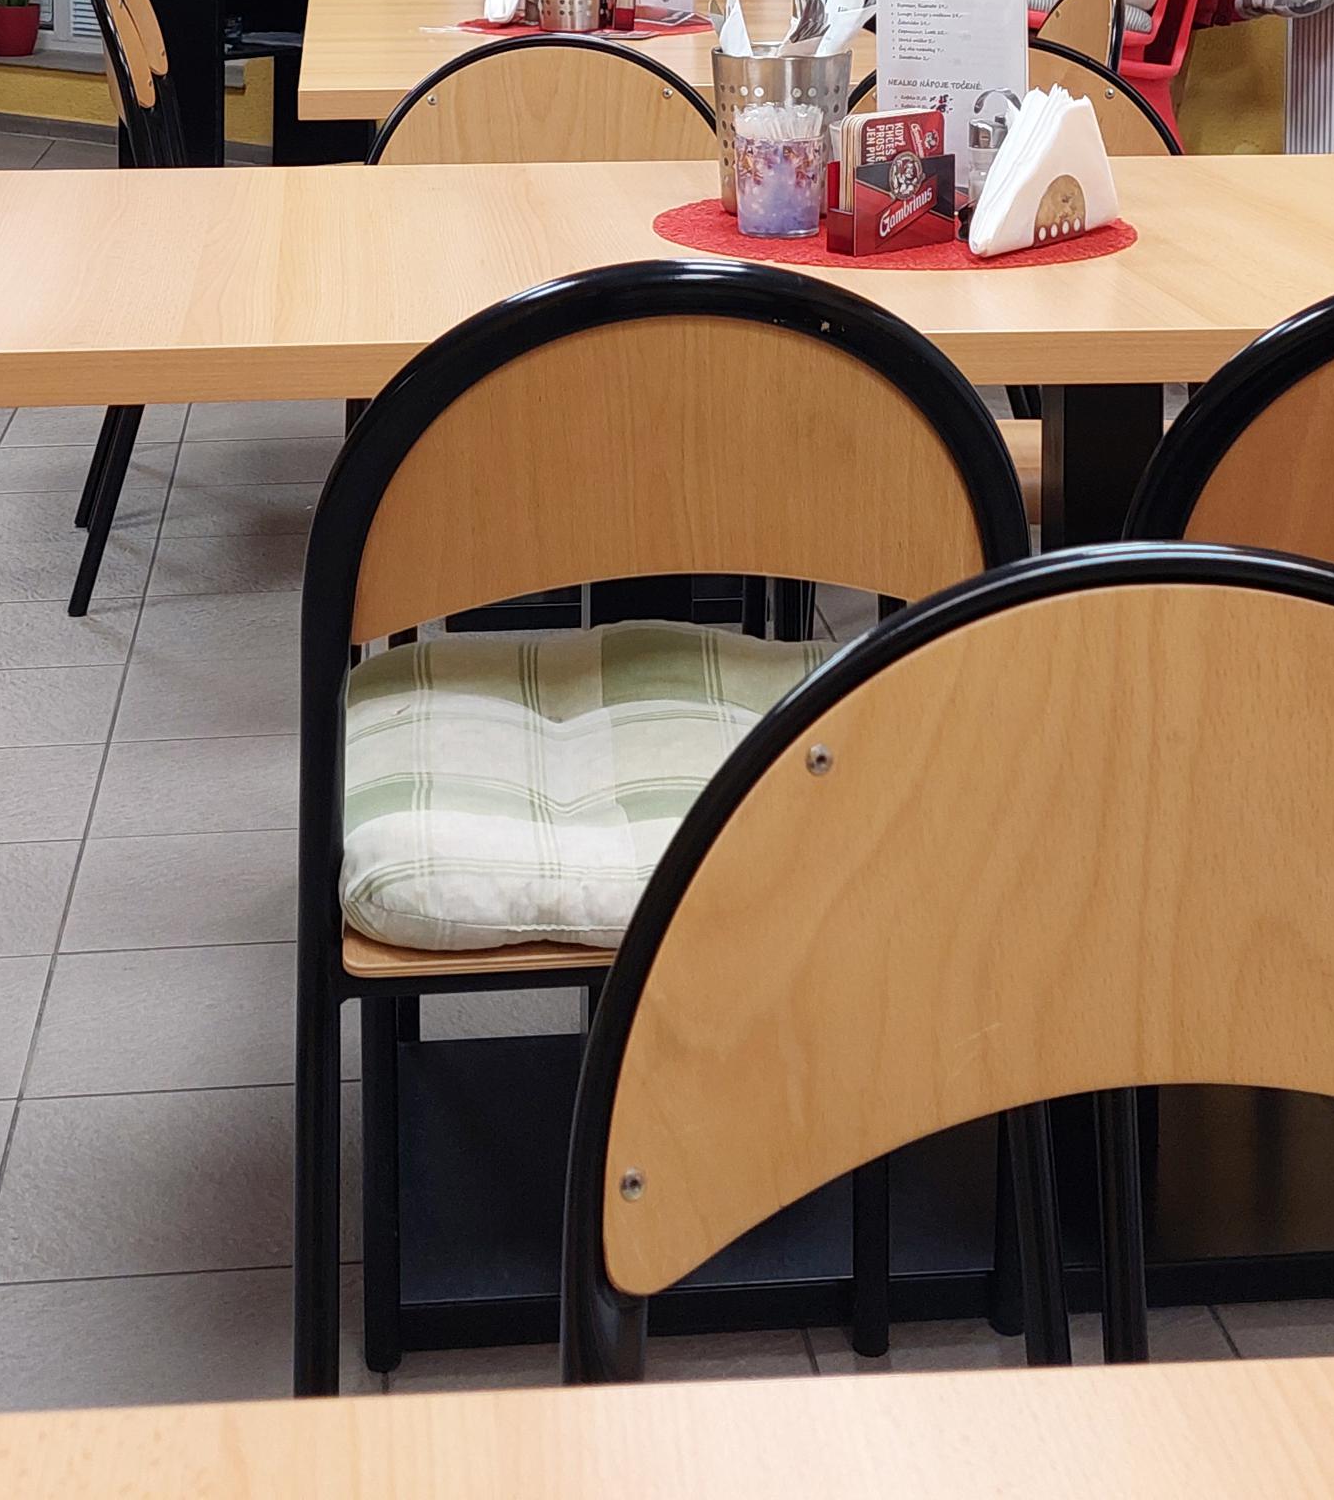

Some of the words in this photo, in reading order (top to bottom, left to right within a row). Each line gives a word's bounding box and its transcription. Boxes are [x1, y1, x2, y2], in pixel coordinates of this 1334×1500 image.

[888, 79, 917, 87] NEALKO
[919, 79, 949, 88] NÁPOJE
[866, 126, 876, 146] JEN
[876, 125, 887, 162] PROSTĚ
[885, 124, 897, 155] CHCEŠ
[895, 122, 906, 146] KDYŽ
[866, 147, 875, 165] PIV
[879, 187, 933, 237] Gambrinus
